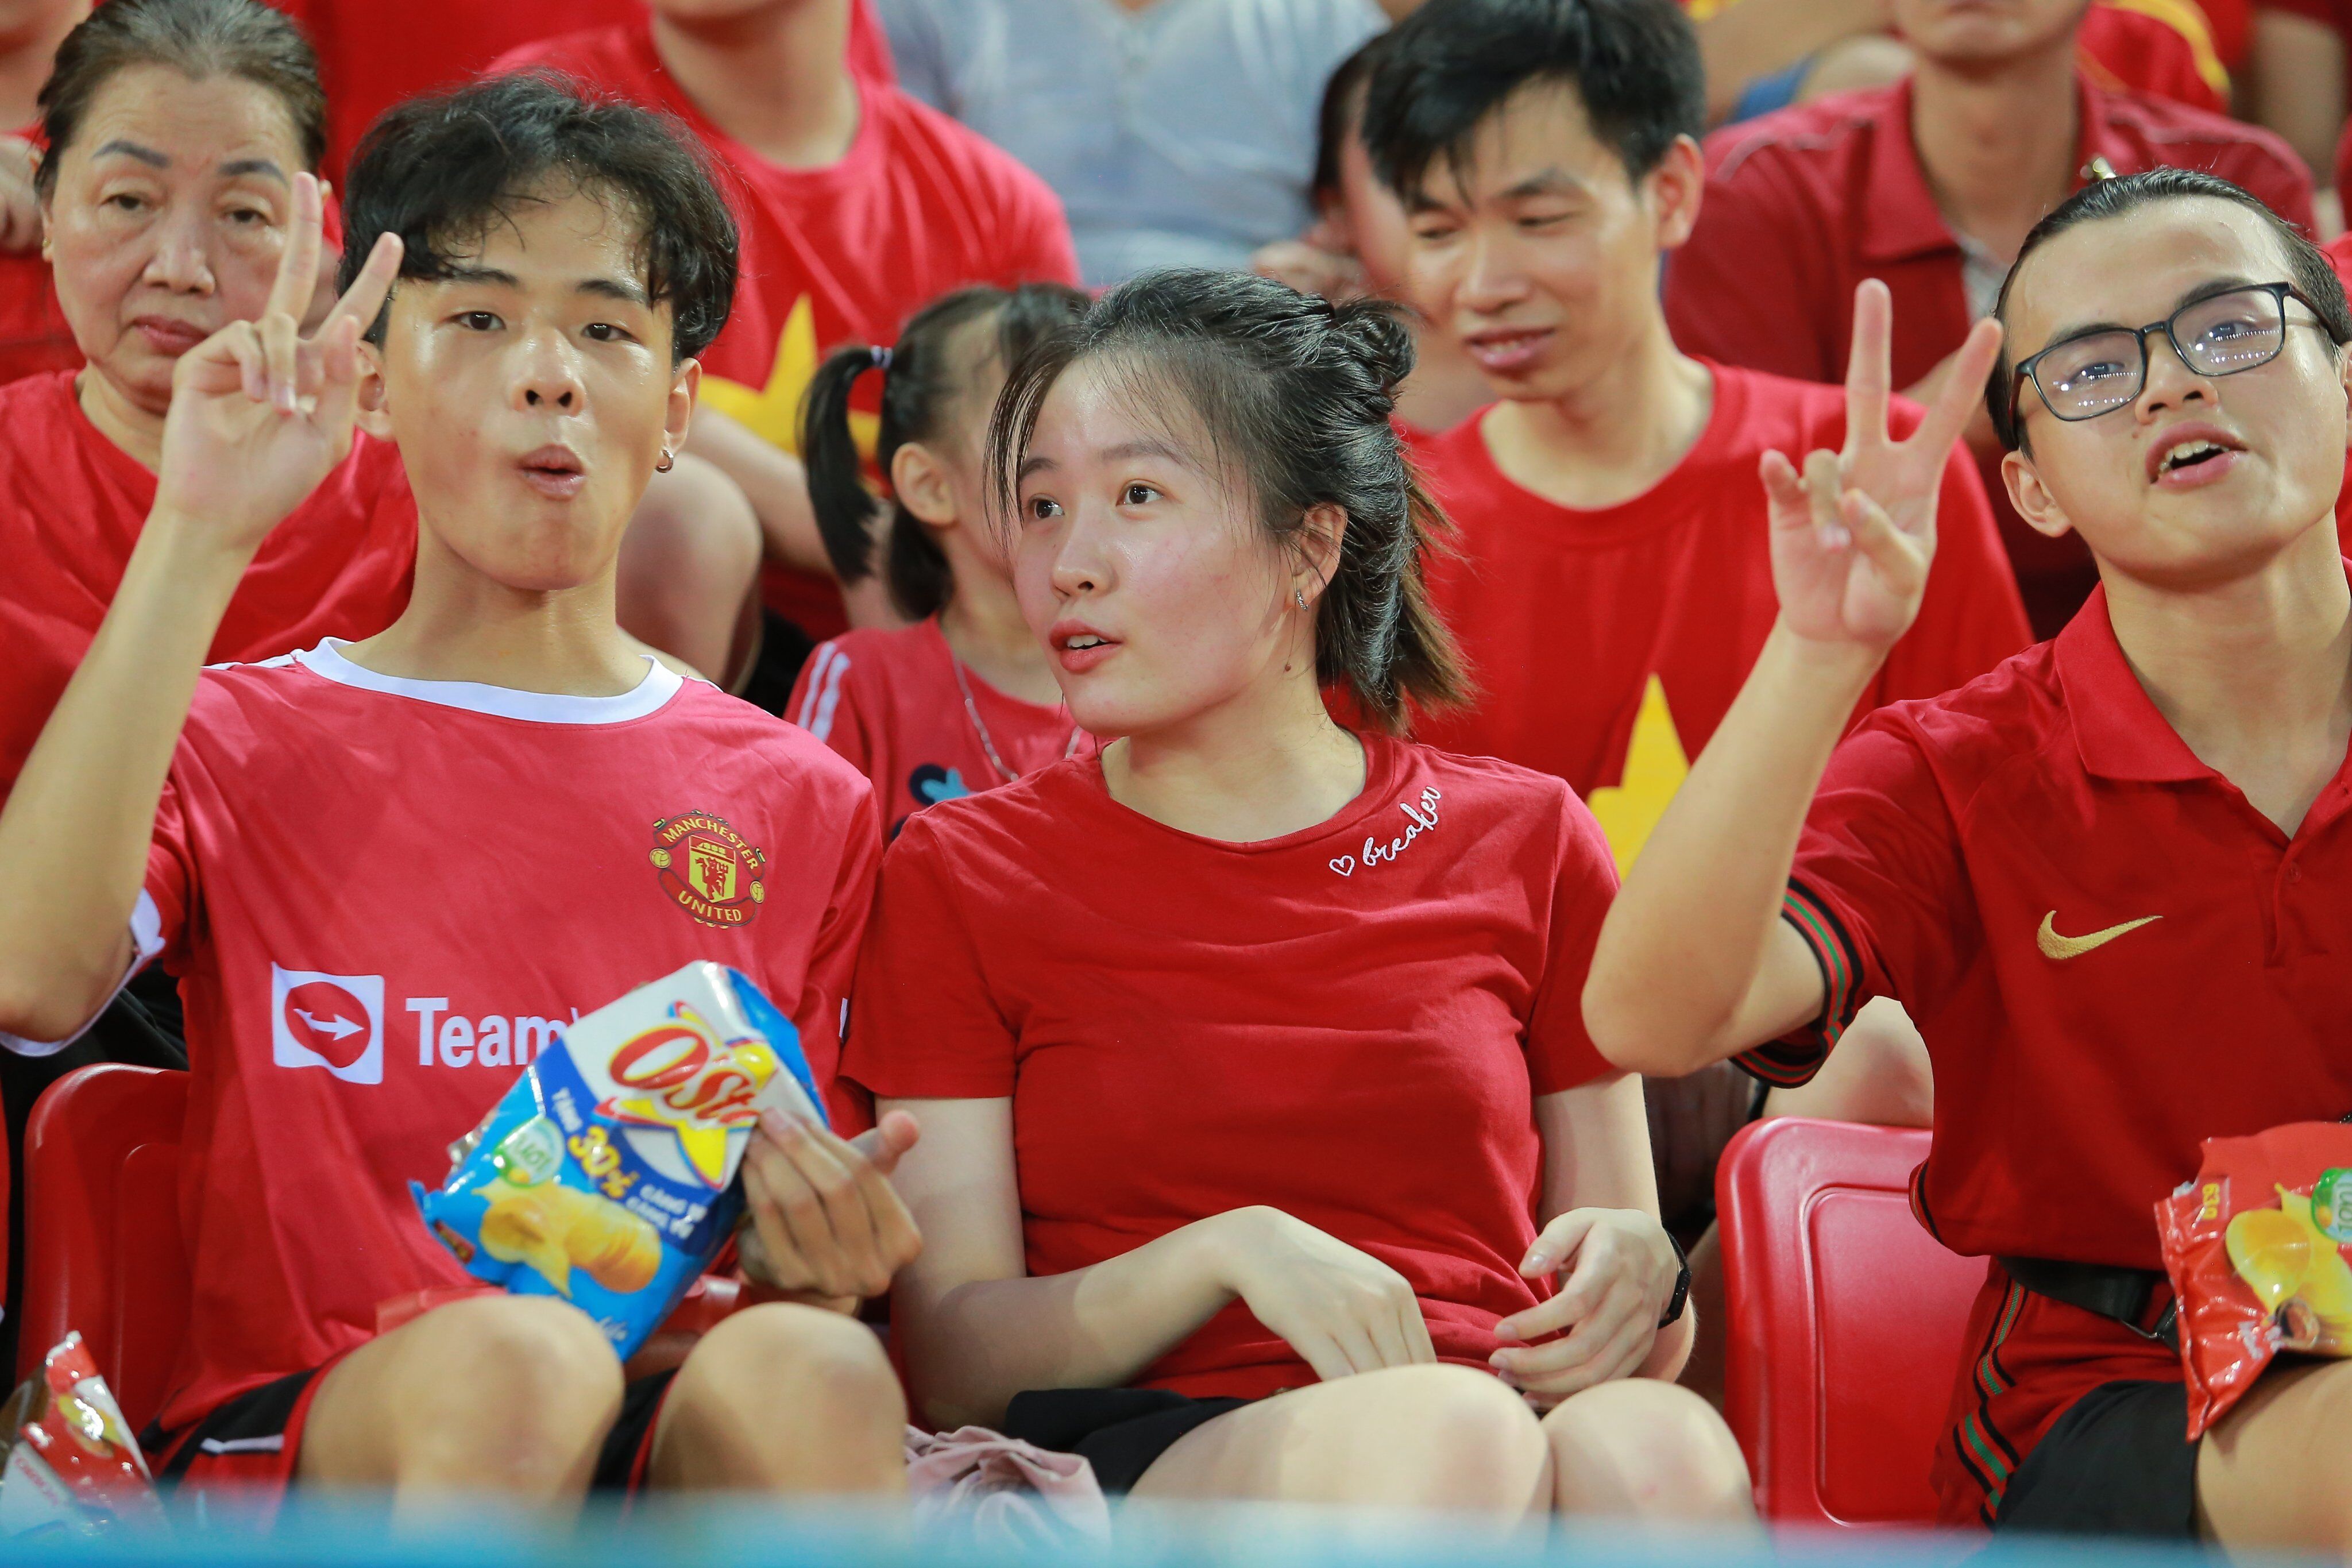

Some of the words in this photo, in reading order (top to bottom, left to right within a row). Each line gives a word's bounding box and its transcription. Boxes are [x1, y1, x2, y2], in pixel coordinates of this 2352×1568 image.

[662, 818, 759, 870] MANCHESTER
[678, 890, 742, 922] UNITED
[405, 997, 578, 1068] Team
